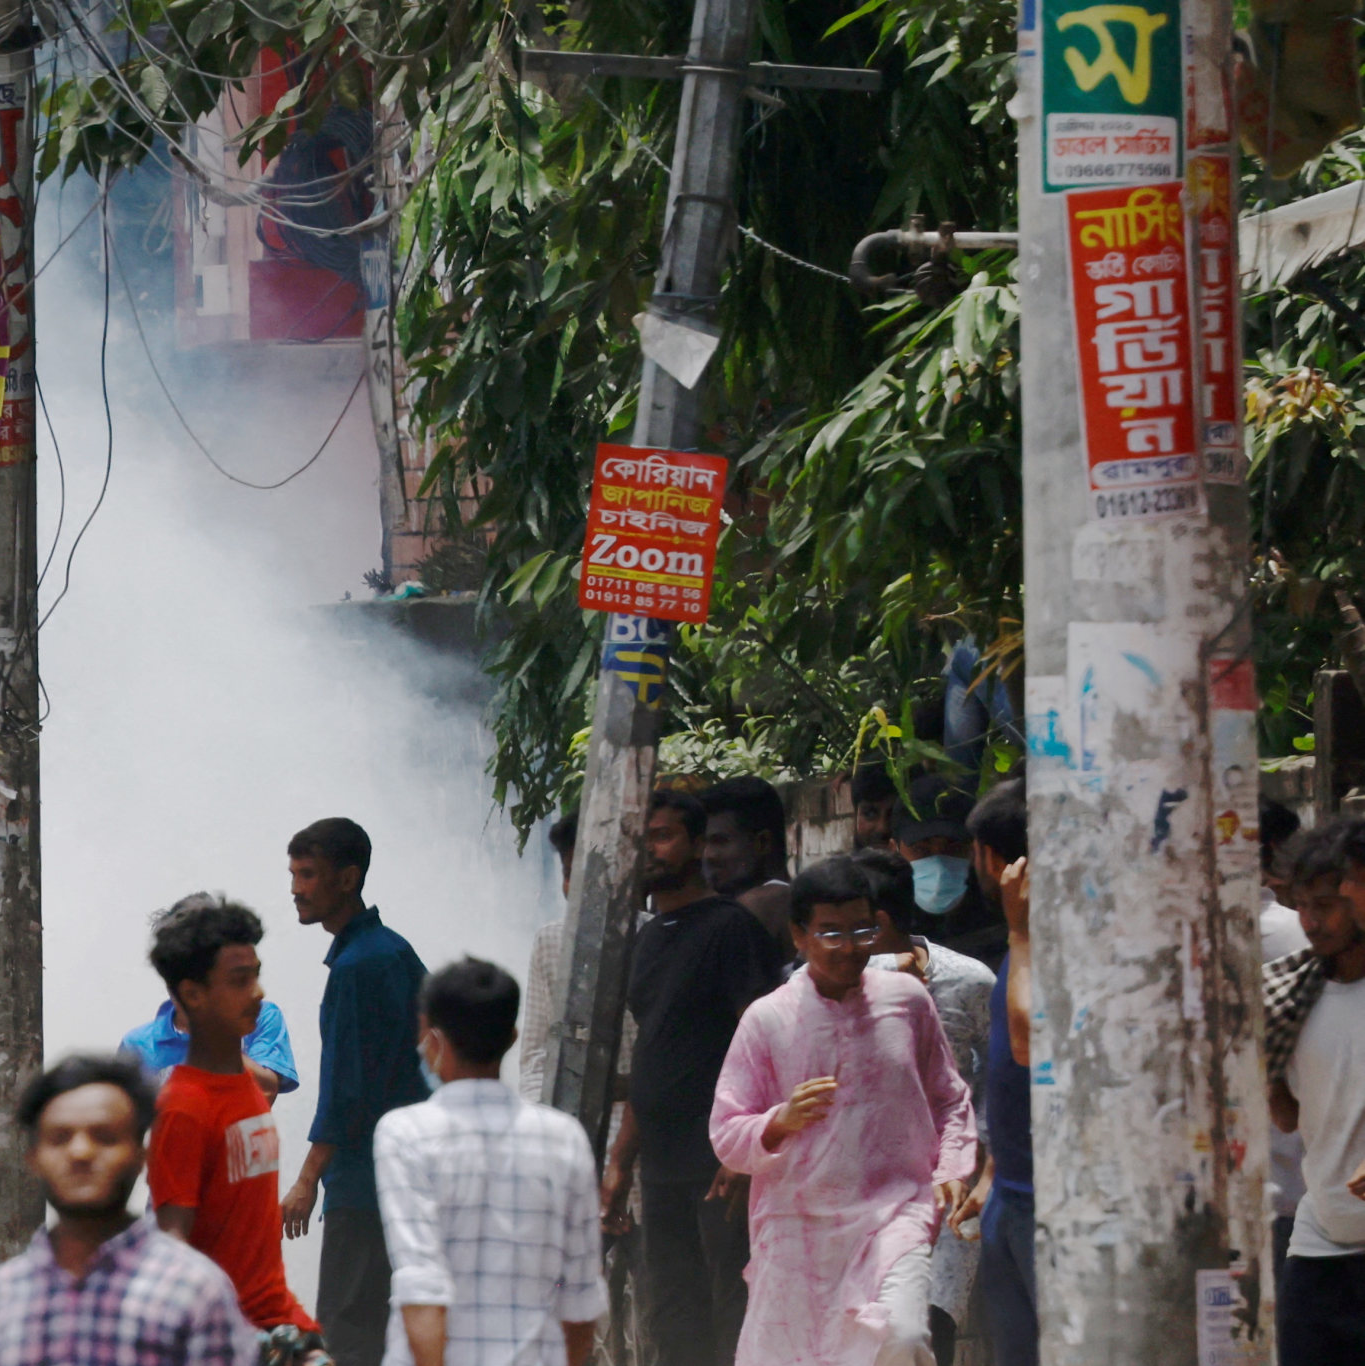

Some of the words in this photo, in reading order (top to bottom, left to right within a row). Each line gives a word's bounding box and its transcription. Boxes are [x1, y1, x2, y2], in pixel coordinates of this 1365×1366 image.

[1075, 188, 1184, 248] নার্সিং
[601, 454, 719, 493] কোরিয়ান
[600, 484, 714, 516] জাপানিজ
[598, 508, 711, 537] চাইনিজ
[588, 533, 705, 577] Zoom
[586, 575, 631, 591] 01711
[585, 589, 632, 605] 01912
[683, 602, 701, 613] 10
